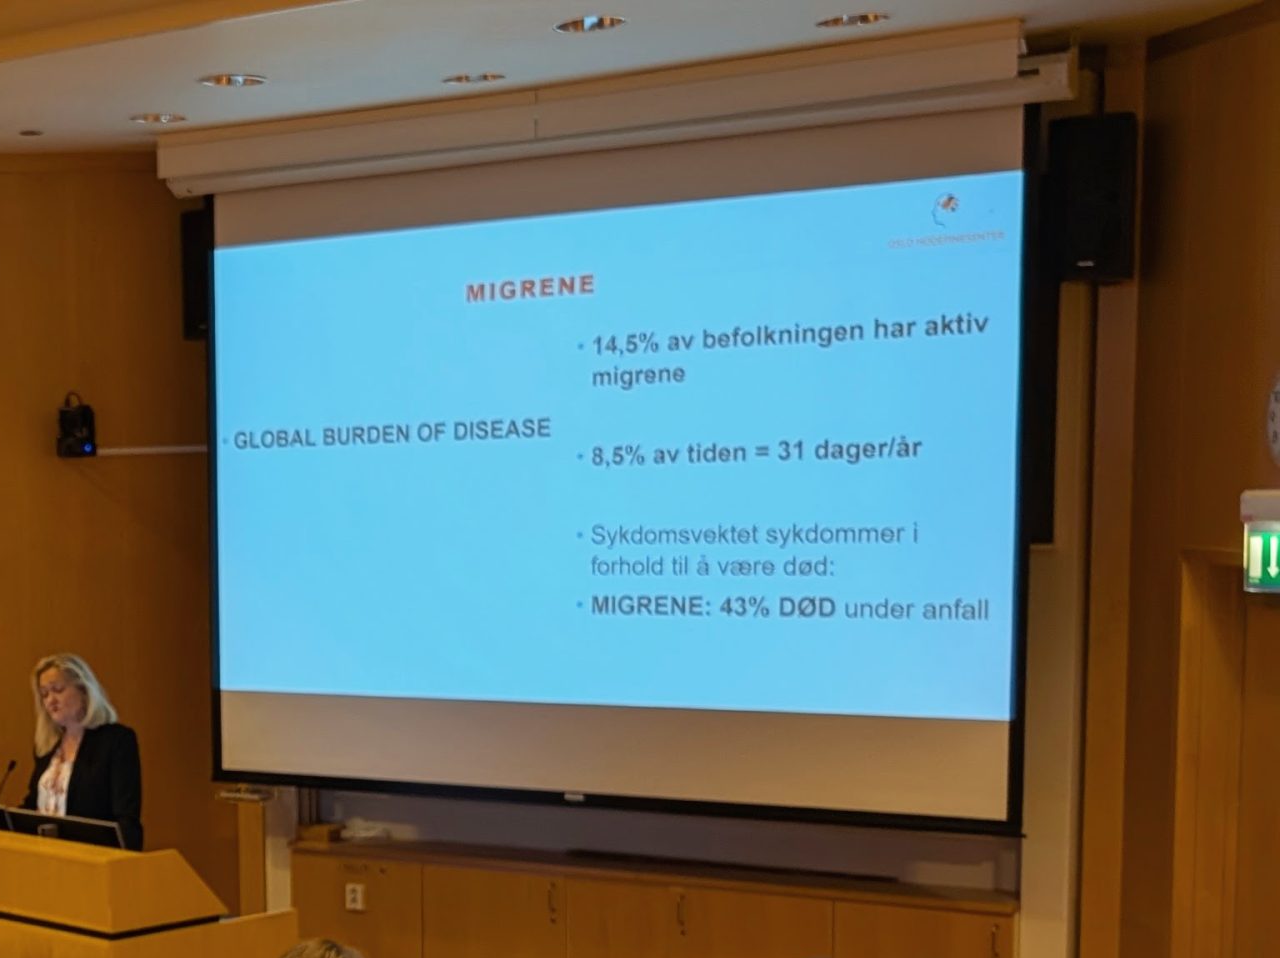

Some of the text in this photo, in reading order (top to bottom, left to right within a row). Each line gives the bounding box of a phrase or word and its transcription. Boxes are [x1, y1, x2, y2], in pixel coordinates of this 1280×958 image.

[467, 274, 596, 303] MIGRENE
[592, 312, 989, 356] 14,5% av befolkningen har aktiv
[592, 366, 686, 391] migrene
[234, 417, 552, 450] GLOBAL BURDEN OF DISEASE
[592, 435, 923, 468] 8,5% av tiden = 31 dager/år
[591, 522, 919, 550] Sykdomsvektet sykdommer i
[591, 555, 835, 577] forhold til å være død:
[591, 594, 990, 621] MIGRENE: 43% DØD under anfall
